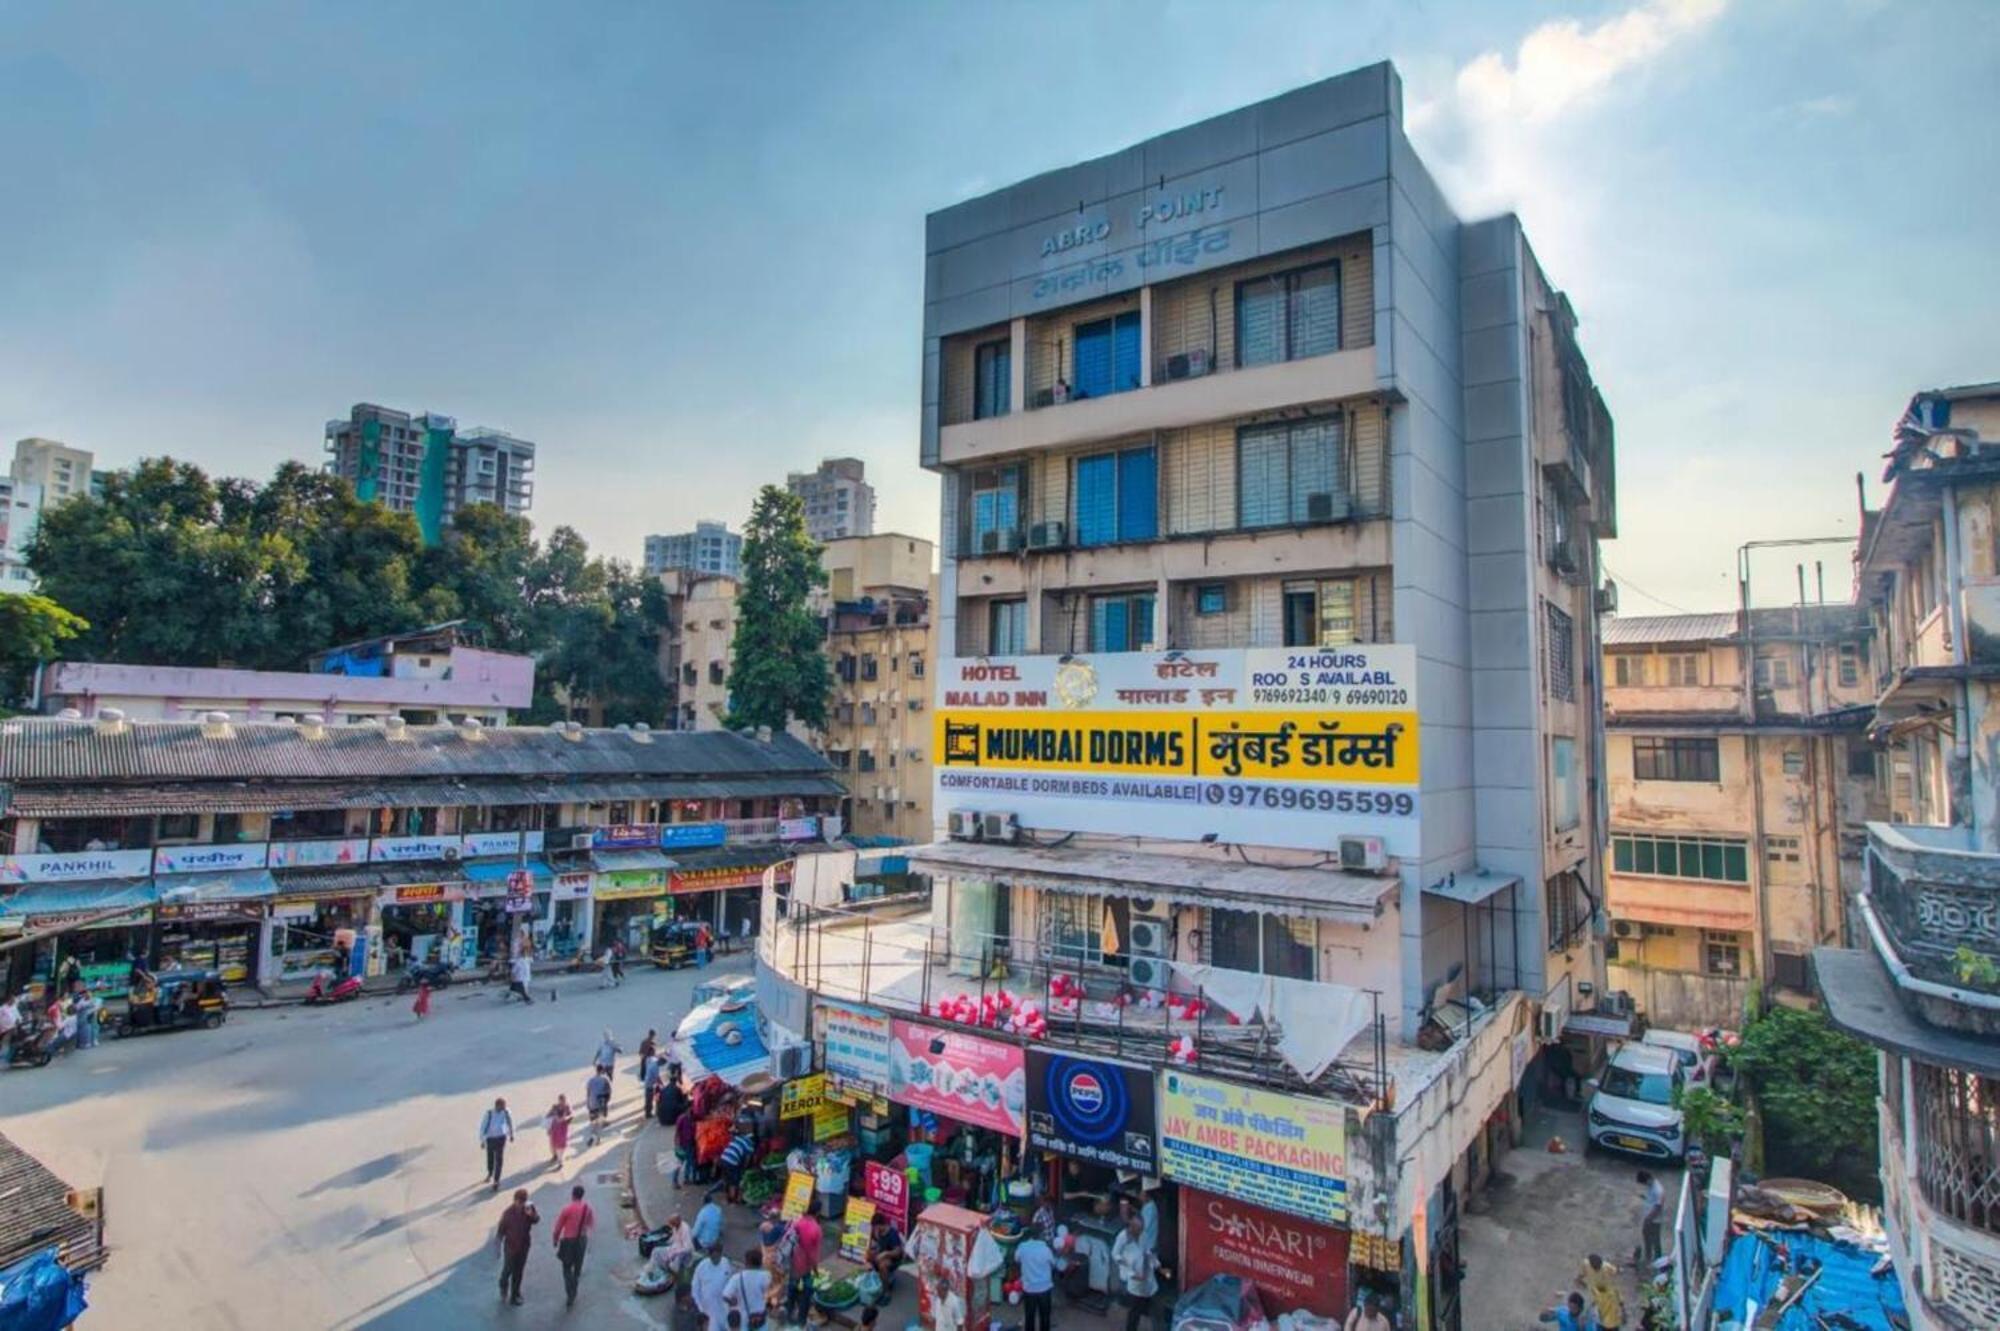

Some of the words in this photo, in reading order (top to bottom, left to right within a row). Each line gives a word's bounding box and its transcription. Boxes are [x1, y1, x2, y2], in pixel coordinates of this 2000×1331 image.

[1040, 220, 1111, 258] ABRO
[1136, 185, 1225, 230] POINT
[1288, 655, 1305, 669] 24
[1310, 654, 1367, 668] HOURS
[961, 665, 1022, 682] HOTEL
[945, 690, 1010, 707] MALAD
[1014, 690, 1048, 707] INN
[1116, 688, 1190, 705] मालाड
[1198, 687, 1238, 707] इन
[986, 728, 1083, 763] MUMBAI
[1089, 729, 1185, 767] DORMS
[1208, 720, 1297, 776] मुंबई
[940, 773, 1029, 792] COMFORTABLE
[1031, 777, 1072, 793] DORM
[1072, 780, 1109, 796] BEDS
[1228, 784, 1415, 817] 9769695599
[40, 859, 116, 873] PANKHIL
[783, 1096, 823, 1113] XEROX
[1164, 1115, 1191, 1138] JAY
[1196, 1123, 1240, 1152] AMBE
[1244, 1135, 1345, 1177] PACKAGING
